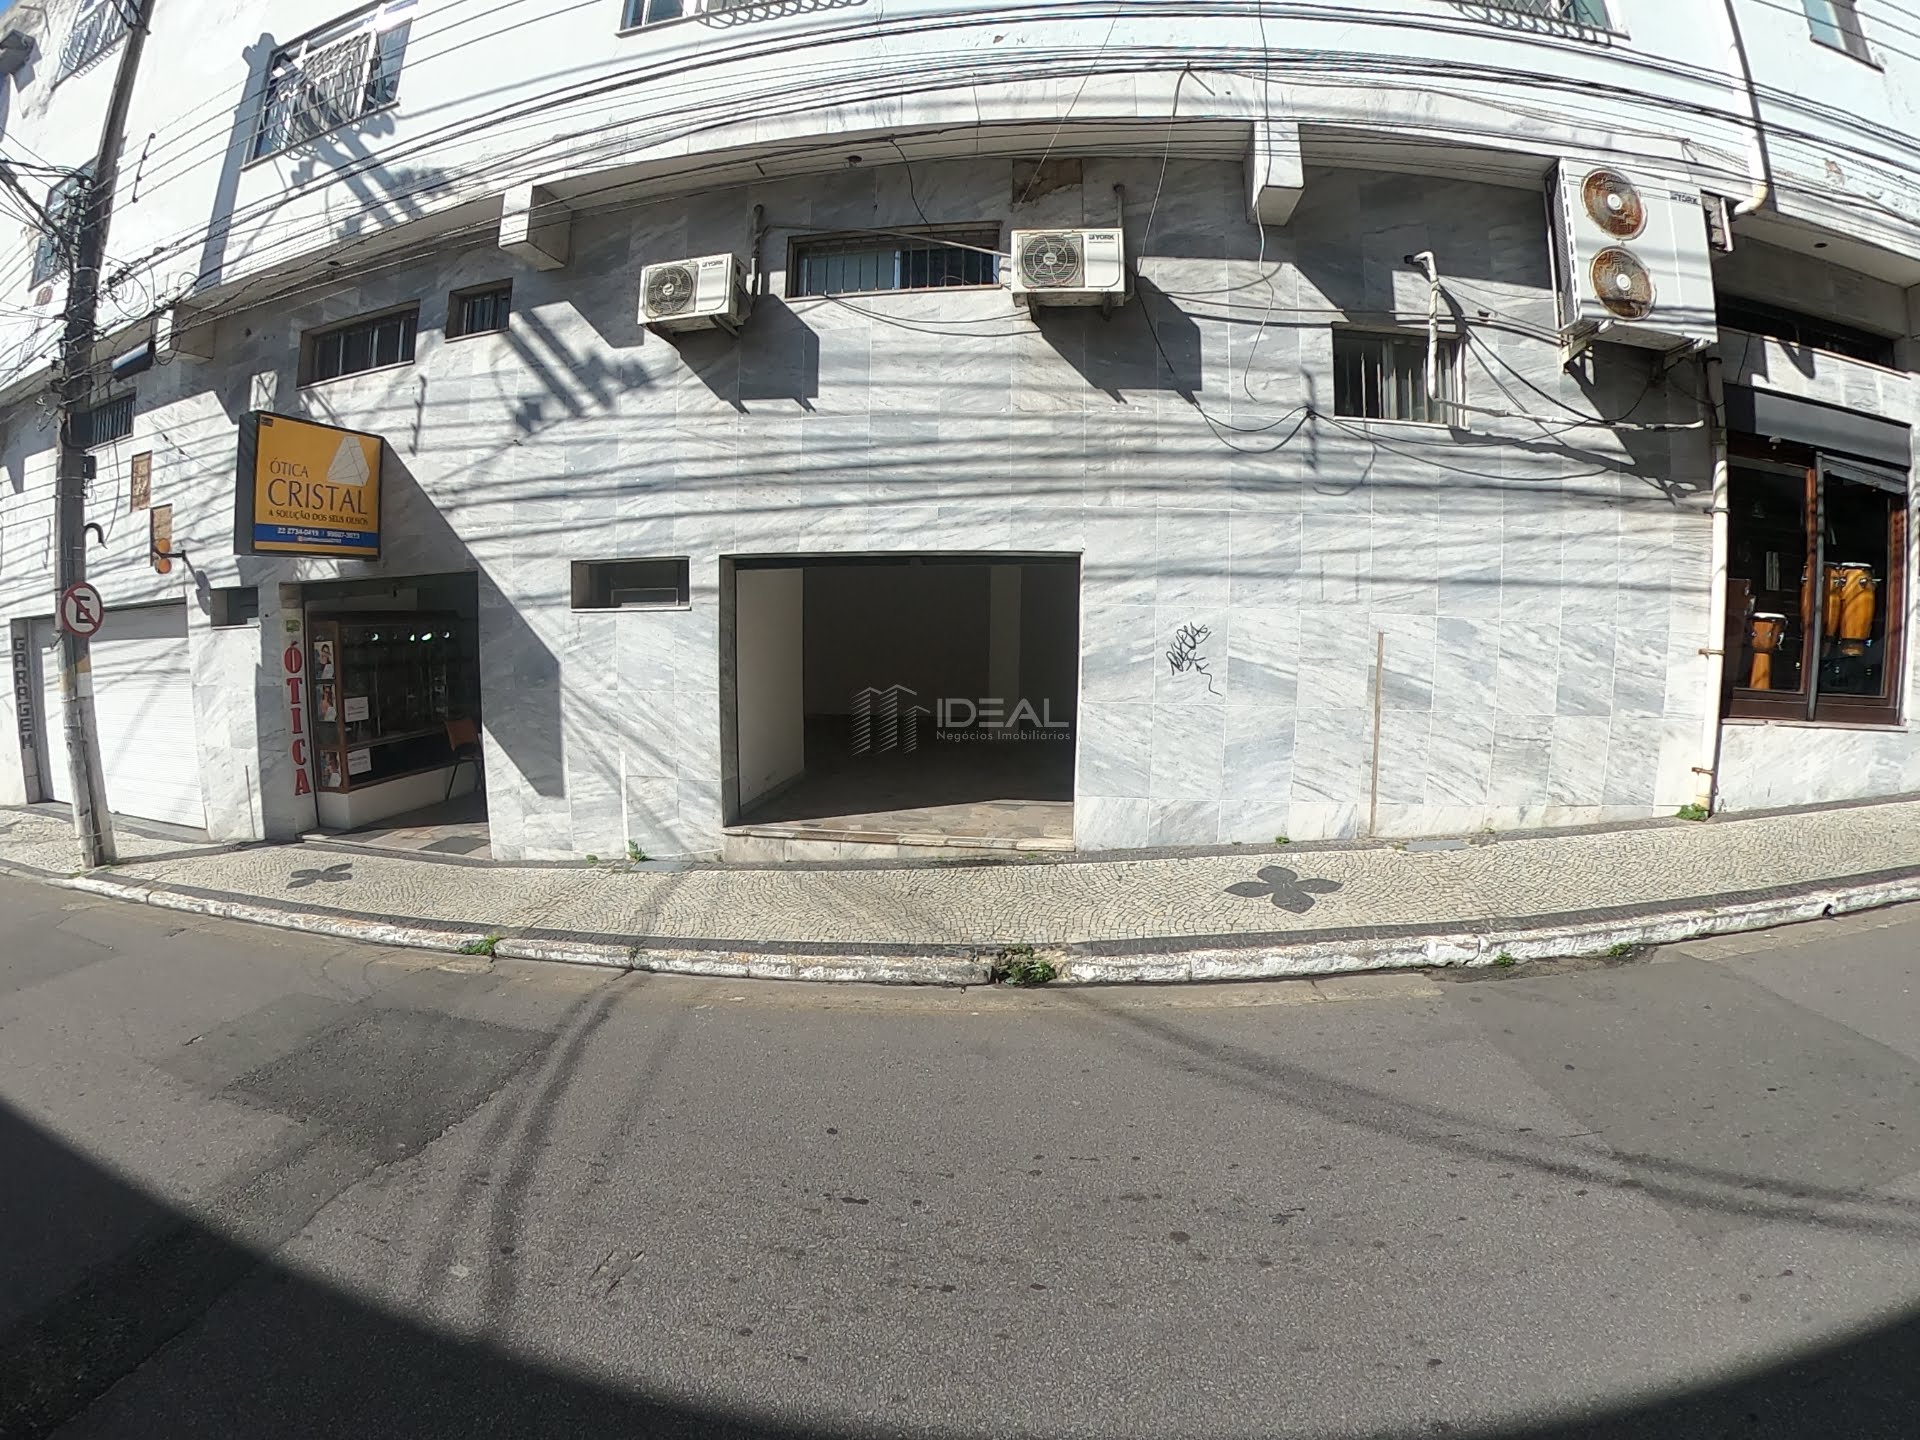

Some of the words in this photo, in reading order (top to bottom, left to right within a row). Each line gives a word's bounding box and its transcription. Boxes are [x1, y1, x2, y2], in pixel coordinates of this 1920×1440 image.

[270, 457, 309, 478] ÓTICA
[267, 478, 368, 515] CRISTAL
[275, 510, 311, 520] SOLUÇÃO
[312, 513, 328, 521] DOS
[14, 637, 34, 749] GARAGEM
[284, 641, 312, 796] ÓTICA
